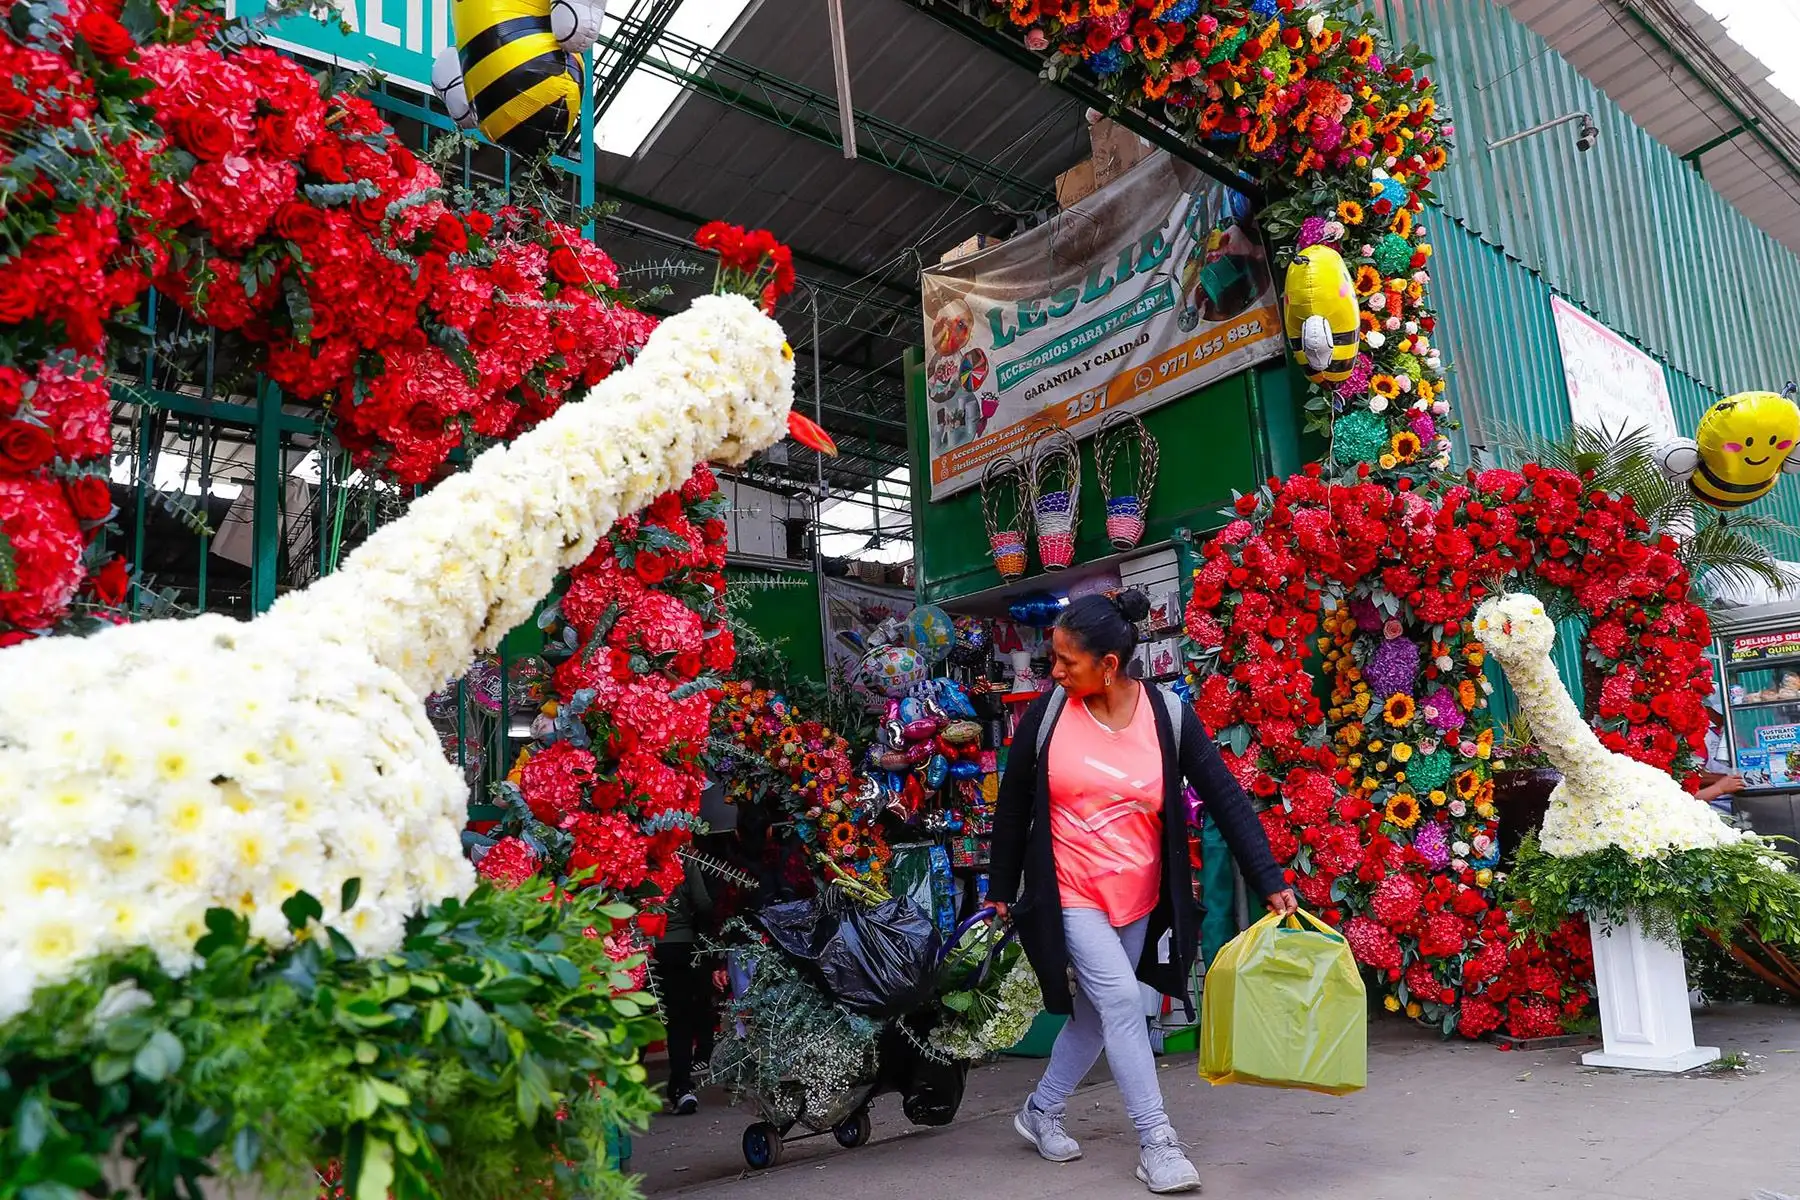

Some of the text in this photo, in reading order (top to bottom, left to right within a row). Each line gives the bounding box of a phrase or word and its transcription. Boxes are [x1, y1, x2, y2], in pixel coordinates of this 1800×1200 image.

[984, 217, 1173, 352] LESLIE
[1000, 341, 1069, 385] ACCESORIOS
[1069, 325, 1102, 350] PARA
[1024, 333, 1150, 401] GARANTIA Y CALIDAD
[1066, 320, 1263, 420] 287 977 455 882
[952, 423, 1026, 461] Accesorios Leslie
[1731, 645, 1800, 660] MACA QUINU
[1739, 631, 1800, 647] DELICIAS DE
